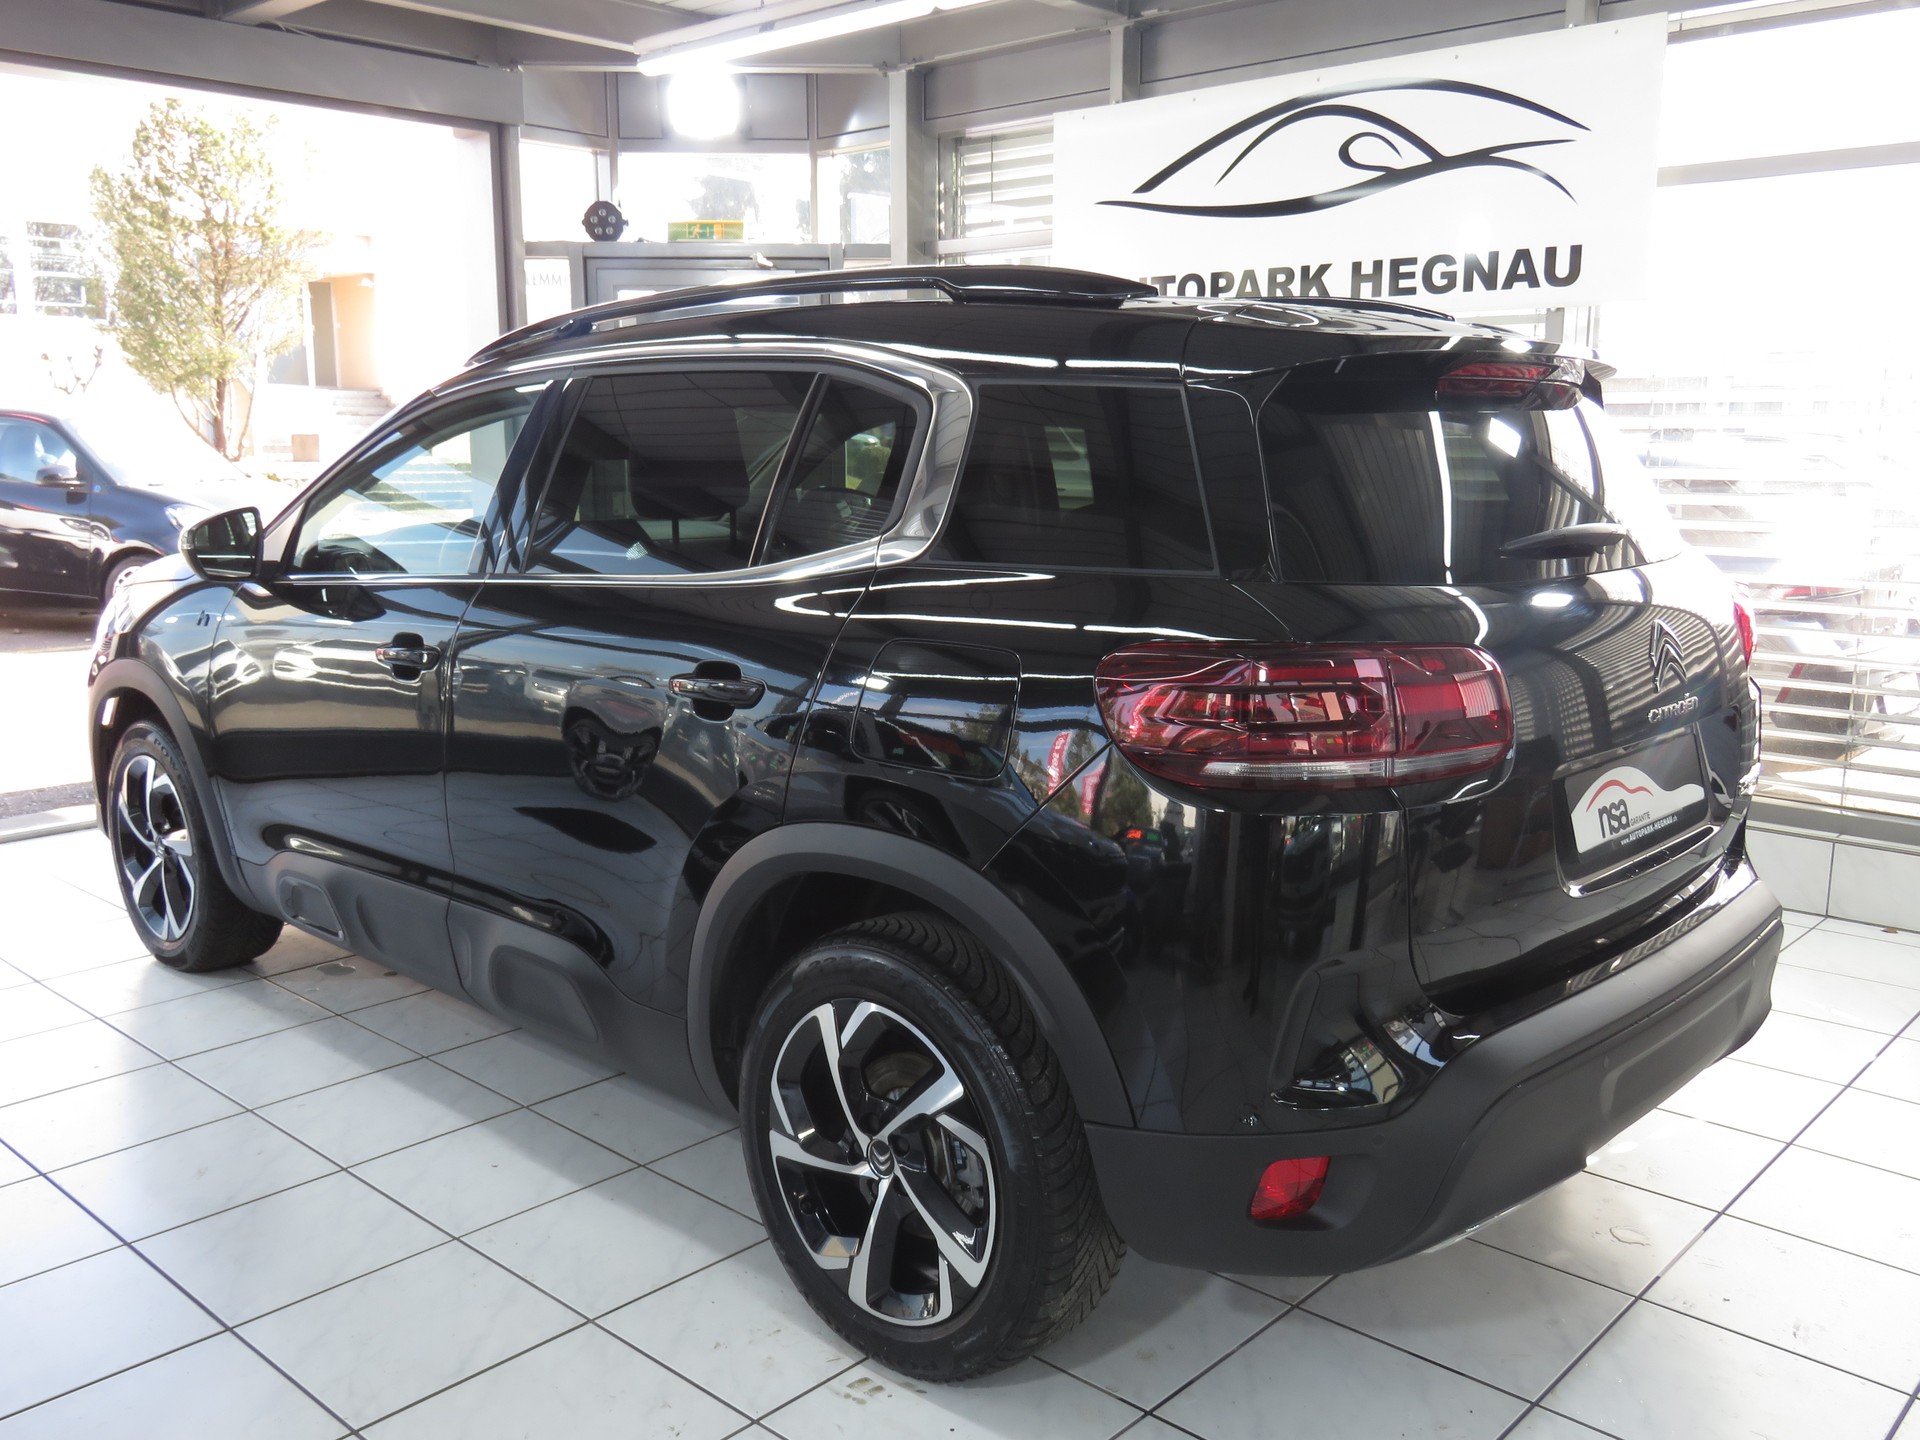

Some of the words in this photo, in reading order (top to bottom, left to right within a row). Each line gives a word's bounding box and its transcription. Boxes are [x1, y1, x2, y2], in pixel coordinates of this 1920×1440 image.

[1351, 244, 1583, 298] HEGNAU
[1598, 798, 1631, 839] nsa
[1630, 810, 1651, 826] GARANTIE
